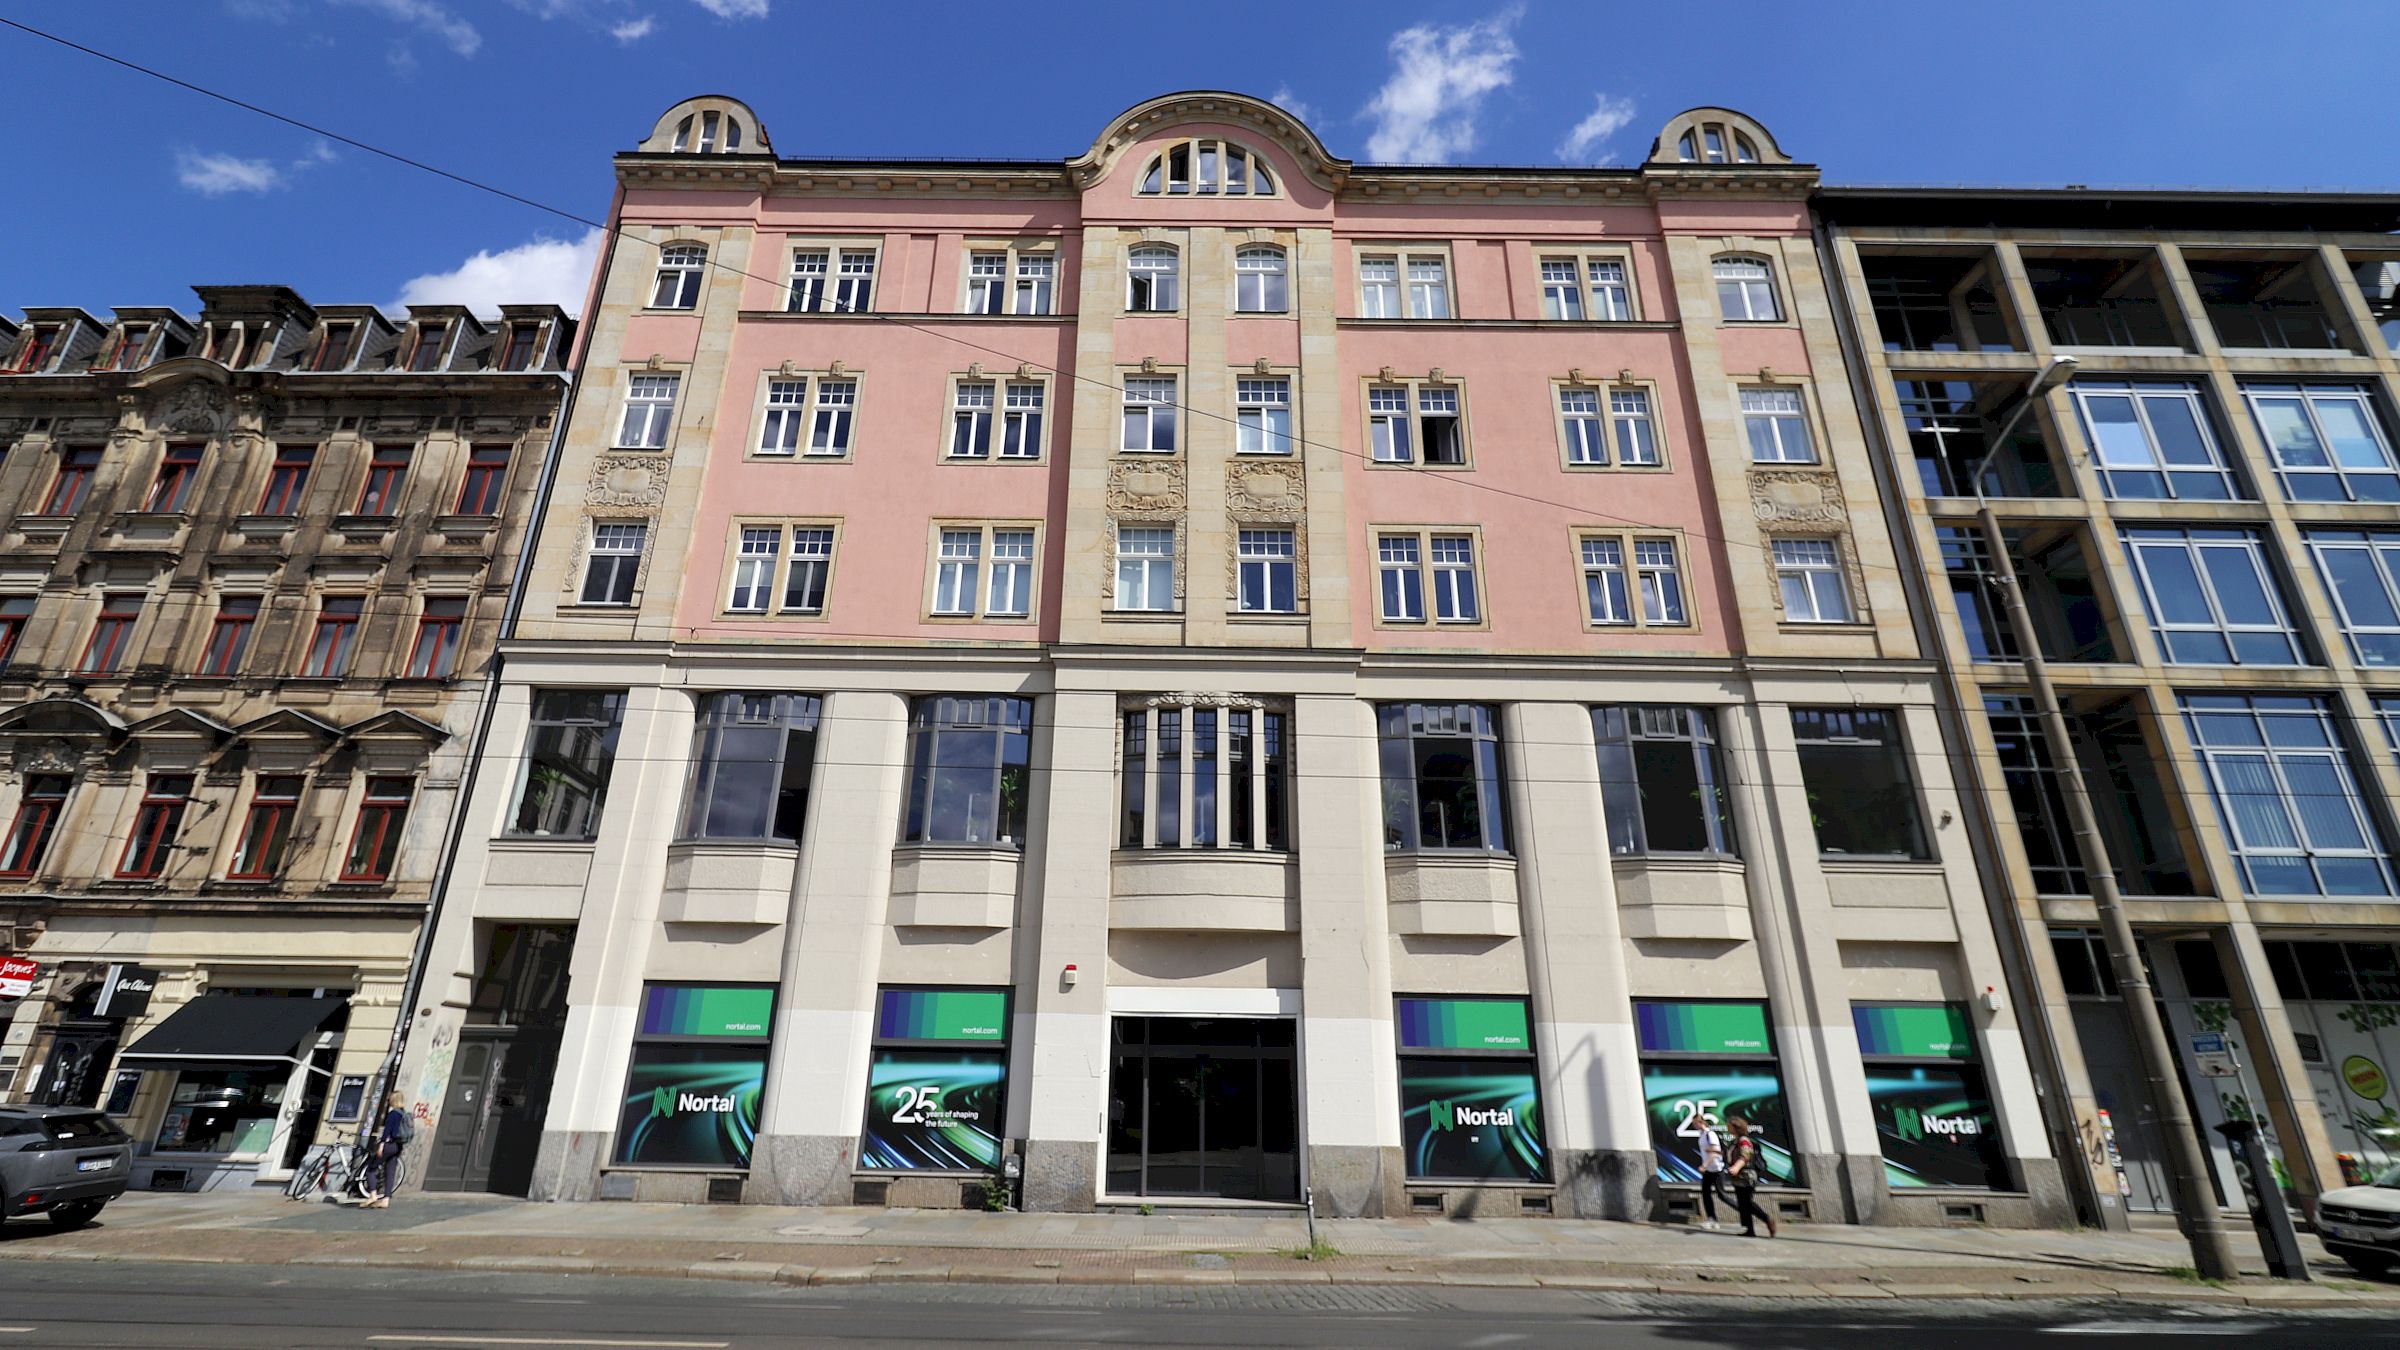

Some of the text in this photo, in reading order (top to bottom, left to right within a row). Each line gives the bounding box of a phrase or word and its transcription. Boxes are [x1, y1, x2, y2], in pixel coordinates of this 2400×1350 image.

[725, 1023, 761, 1031] nortal.com
[962, 1027, 998, 1035] nortal.com
[1484, 1036, 1521, 1044] nortal.com
[678, 1093, 736, 1112] Nortal
[892, 1086, 940, 1124] 25
[925, 1110, 979, 1120] years of shaping
[1456, 1107, 1513, 1126] Nortal
[1673, 1099, 1719, 1138] 25
[925, 1120, 958, 1128] the future
[1921, 1114, 1982, 1134] Nortal
